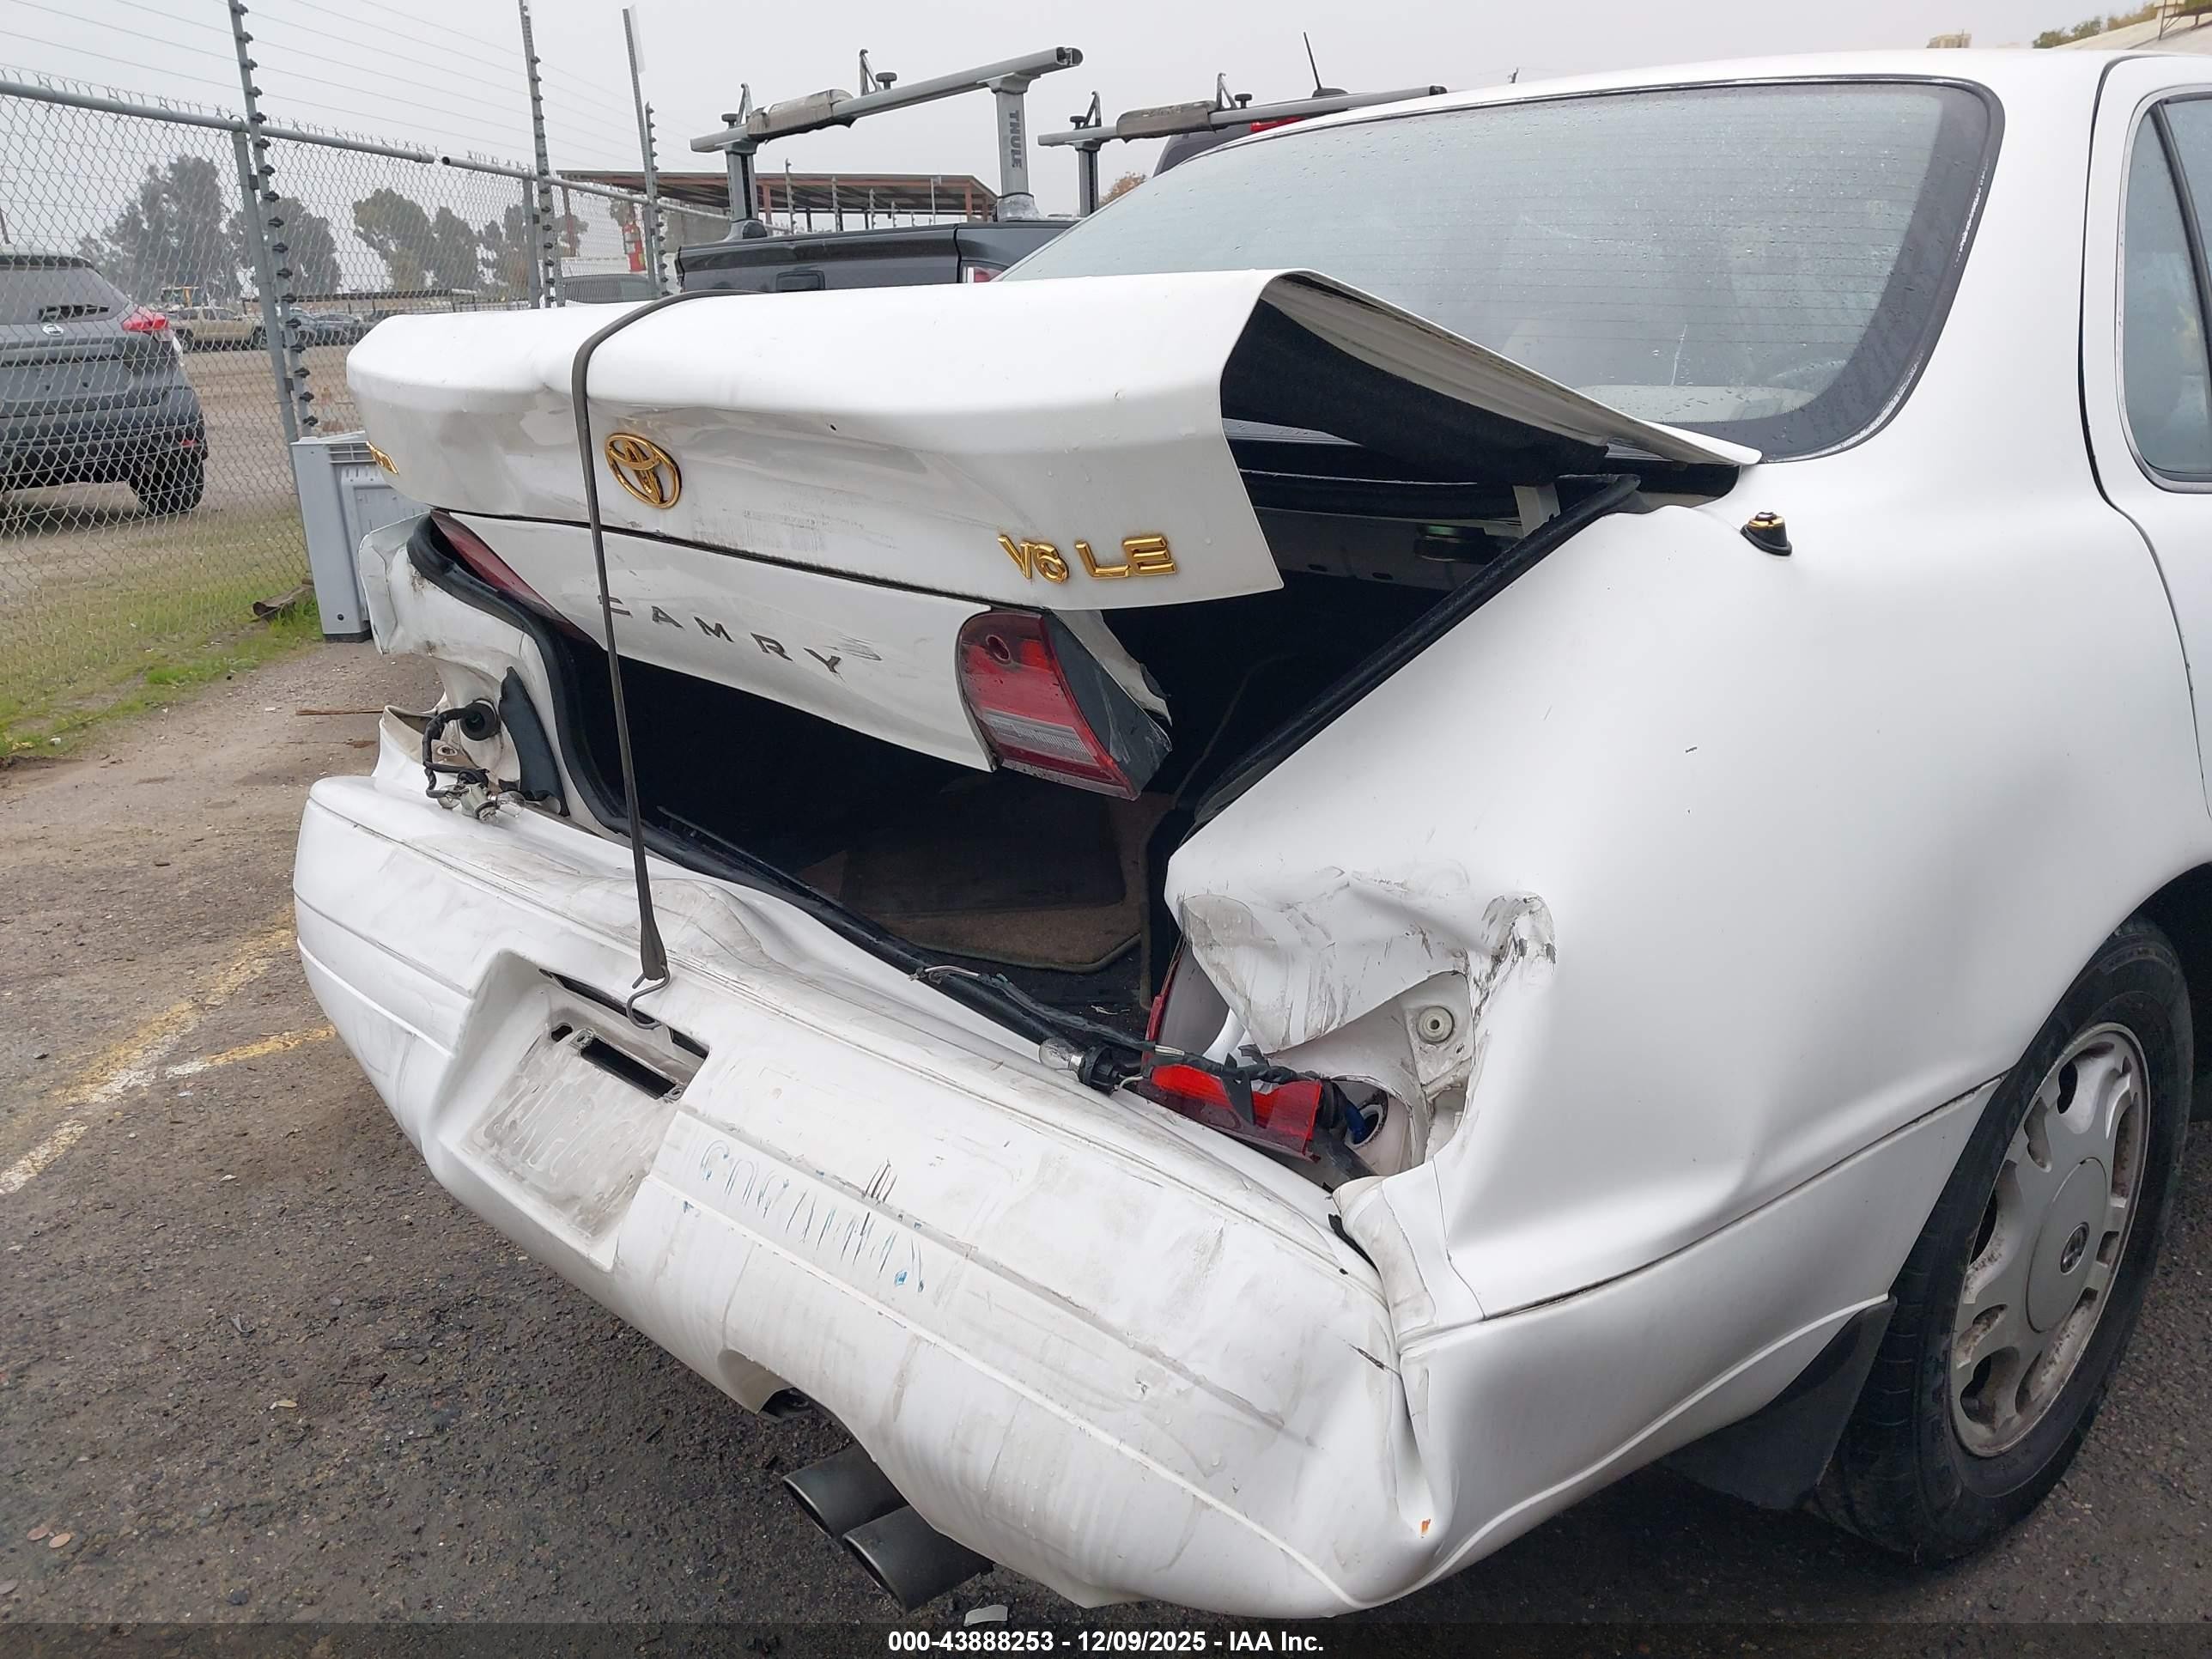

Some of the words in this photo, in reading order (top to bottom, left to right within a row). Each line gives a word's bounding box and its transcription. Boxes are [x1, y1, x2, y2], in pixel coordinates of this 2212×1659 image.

[1009, 109, 1023, 169] THULE
[997, 534, 1070, 585] V6
[1075, 534, 1177, 580] LE
